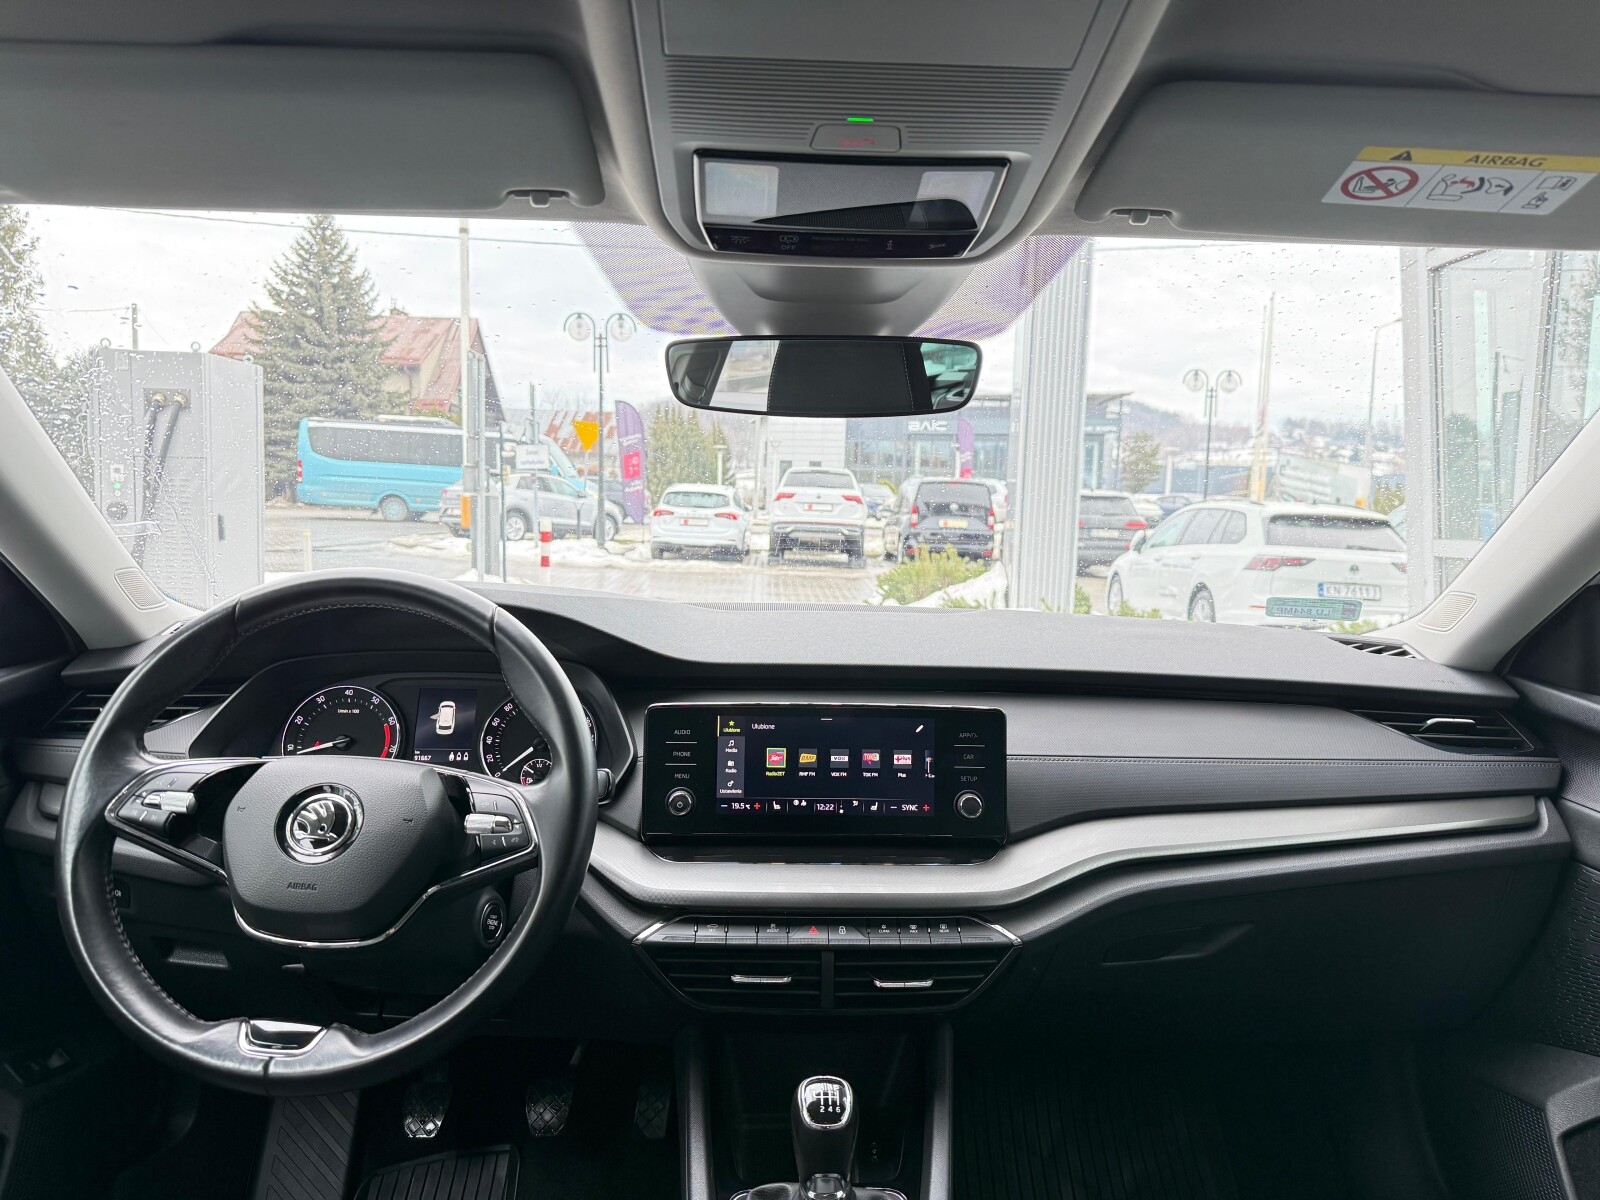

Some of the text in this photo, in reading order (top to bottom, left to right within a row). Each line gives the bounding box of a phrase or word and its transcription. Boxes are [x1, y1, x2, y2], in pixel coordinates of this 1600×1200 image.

[1464, 154, 1548, 168] AIRBAG
[316, 695, 326, 704] 30
[370, 696, 380, 705] 50
[504, 703, 514, 712] 80
[294, 715, 304, 725] 20
[388, 716, 396, 726] 60
[491, 717, 500, 726] 60
[486, 735, 493, 744] 40
[287, 743, 294, 752] 10
[486, 754, 494, 763] 20
[731, 802, 745, 810] 19.5
[816, 803, 834, 811] 12:22
[286, 882, 318, 891] AIRBAG
[819, 1105, 841, 1114] 2 4 6
